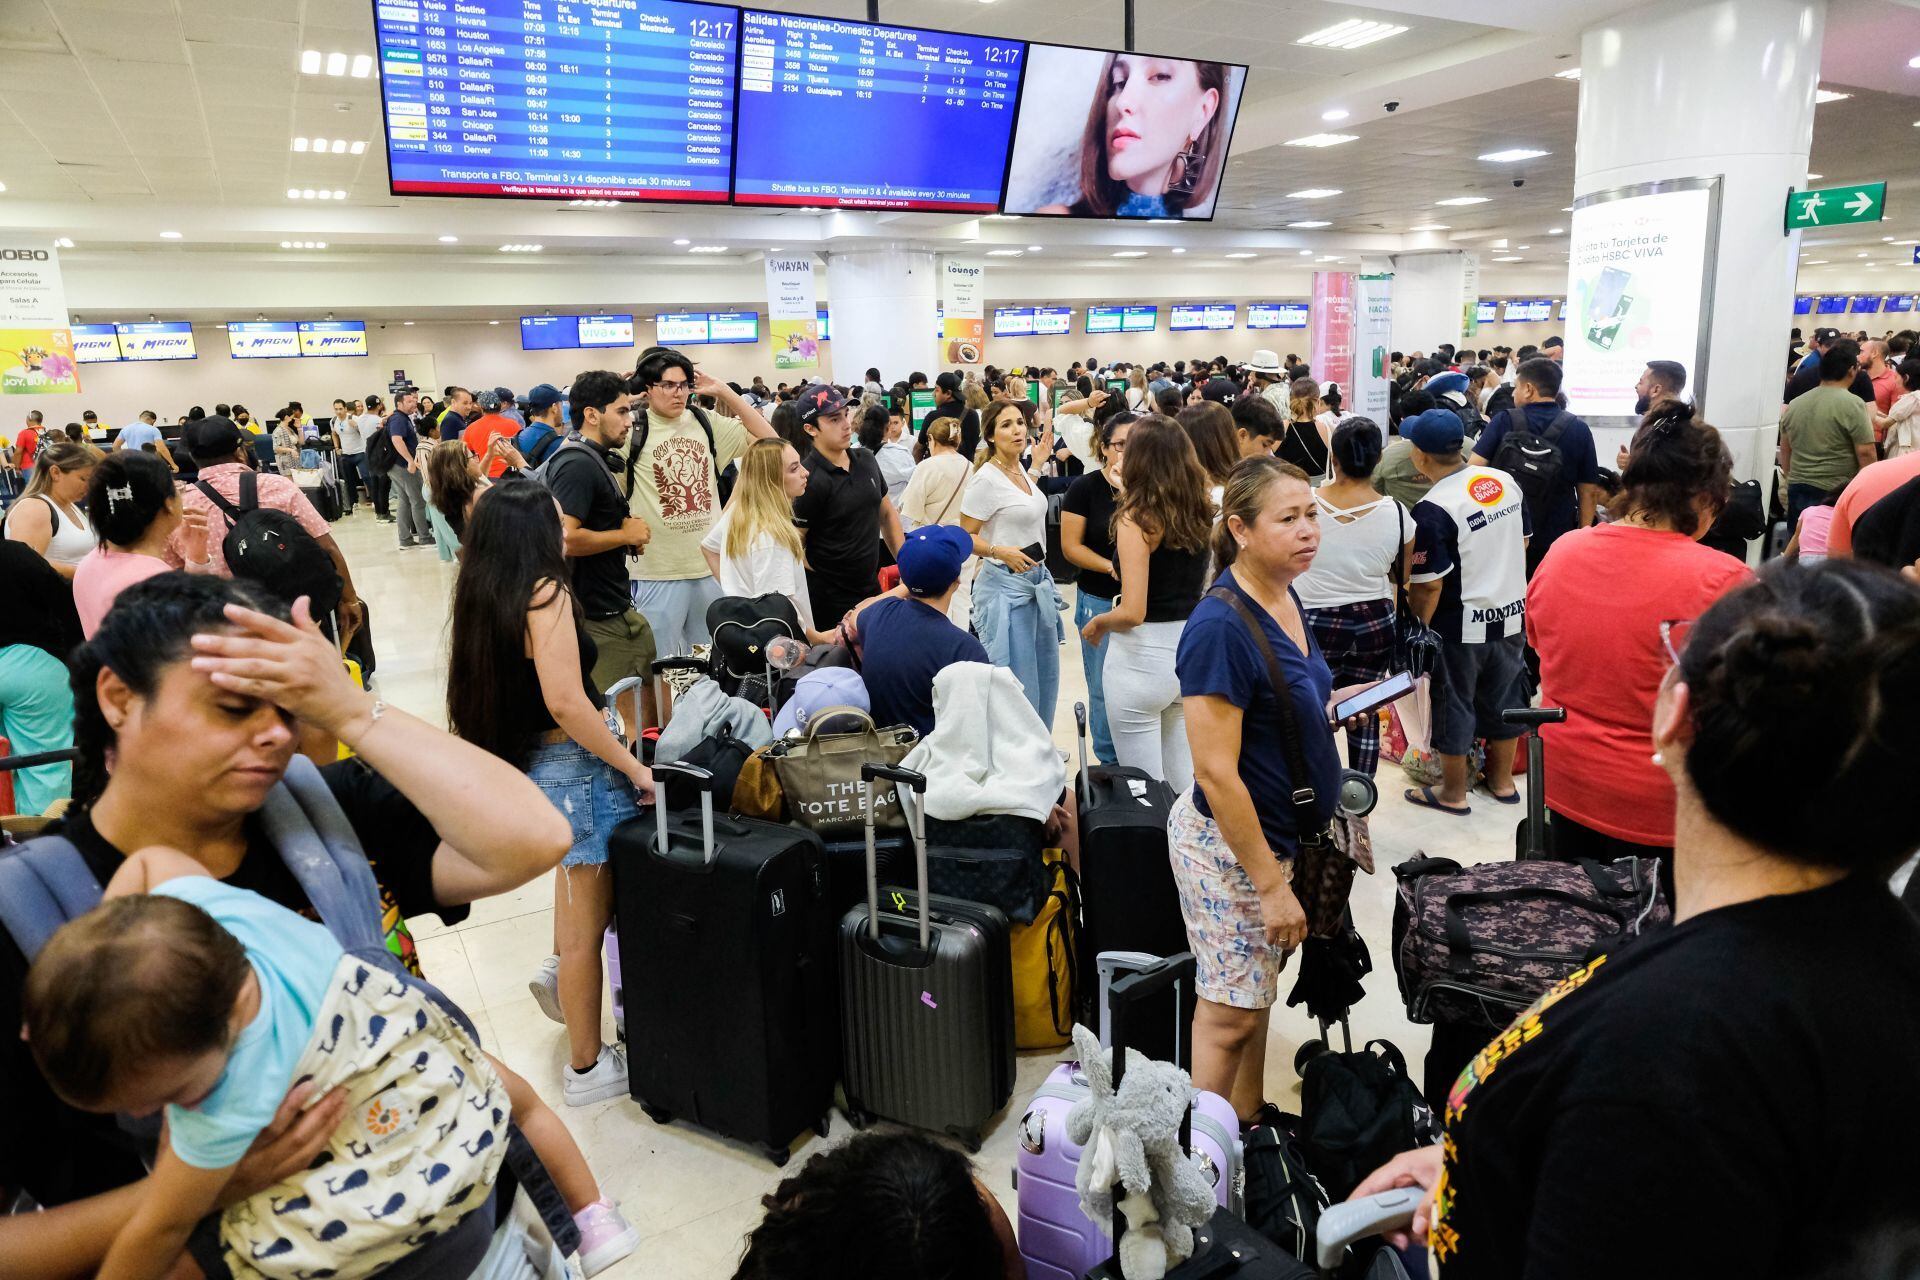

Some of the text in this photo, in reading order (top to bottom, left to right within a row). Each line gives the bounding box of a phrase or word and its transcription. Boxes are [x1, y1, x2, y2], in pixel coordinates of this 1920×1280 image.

[423, 1, 486, 14] Vuelo Destino
[523, 1, 541, 10] Time
[591, 8, 619, 18] Terminal
[640, 14, 668, 24] Check-in
[424, 13, 725, 49] 312 Havana Cancelado
[592, 18, 622, 28] Terminal
[640, 23, 675, 34] Mostrador
[690, 19, 733, 39] 12:17
[744, 13, 917, 41] Salidas Nacionales-Domestic Departures
[457, 30, 489, 40] Houston
[524, 36, 545, 45] 07:51
[690, 51, 725, 62] Cancelado
[745, 27, 764, 35] Airline
[787, 31, 803, 40] Flight
[946, 48, 969, 56] Check-in
[984, 47, 1019, 63] 12:17
[810, 42, 833, 51] Destino
[458, 44, 471, 52] Los
[473, 45, 505, 56] Angeles
[689, 63, 724, 73] Cancelado
[809, 53, 839, 63] Monterrey
[458, 56, 493, 67] Dallas/Ft
[689, 75, 723, 85] Cancelado
[808, 63, 828, 72] Toluca
[459, 70, 723, 97] Orlando Cancelado
[807, 87, 842, 96] Guadalajara
[429, 80, 444, 89] 510
[460, 82, 494, 93] Dallas/Ft
[688, 99, 722, 108] Cancelado
[461, 95, 495, 105] Dallas/Ft
[688, 111, 722, 120] Cancelado
[462, 108, 477, 117] San
[479, 110, 497, 118] Jose
[528, 112, 548, 121] 10:14
[688, 122, 721, 131] Cancelado
[462, 121, 493, 131] Chicago
[687, 134, 721, 142] Cancelado
[463, 133, 496, 143] Dallas/Ft
[687, 145, 720, 154] Cancelado
[434, 144, 452, 153] 1102
[464, 146, 491, 154] Denver
[687, 156, 719, 164] Demorado
[441, 169, 489, 180] Transporte
[525, 172, 560, 182] Terminal
[586, 175, 625, 185] disponible
[628, 177, 647, 185] cada
[661, 178, 691, 186] minutos
[772, 184, 796, 192] Shuttle
[841, 187, 869, 195] Terminal
[889, 189, 916, 197] available
[1612, 237, 1649, 248] Tarjeta
[1653, 234, 1668, 243] de
[1602, 250, 1631, 262] HSBC
[1634, 247, 1663, 258] VIVA
[777, 261, 809, 271] WAYAN
[143, 339, 187, 349] MAGNI
[252, 338, 293, 347] MAGNI
[320, 337, 360, 346] MAGNI
[1472, 598, 1526, 622] MONTER
[827, 781, 866, 796] THE
[798, 799, 850, 814] TOTE
[846, 812, 879, 821] JACOS
